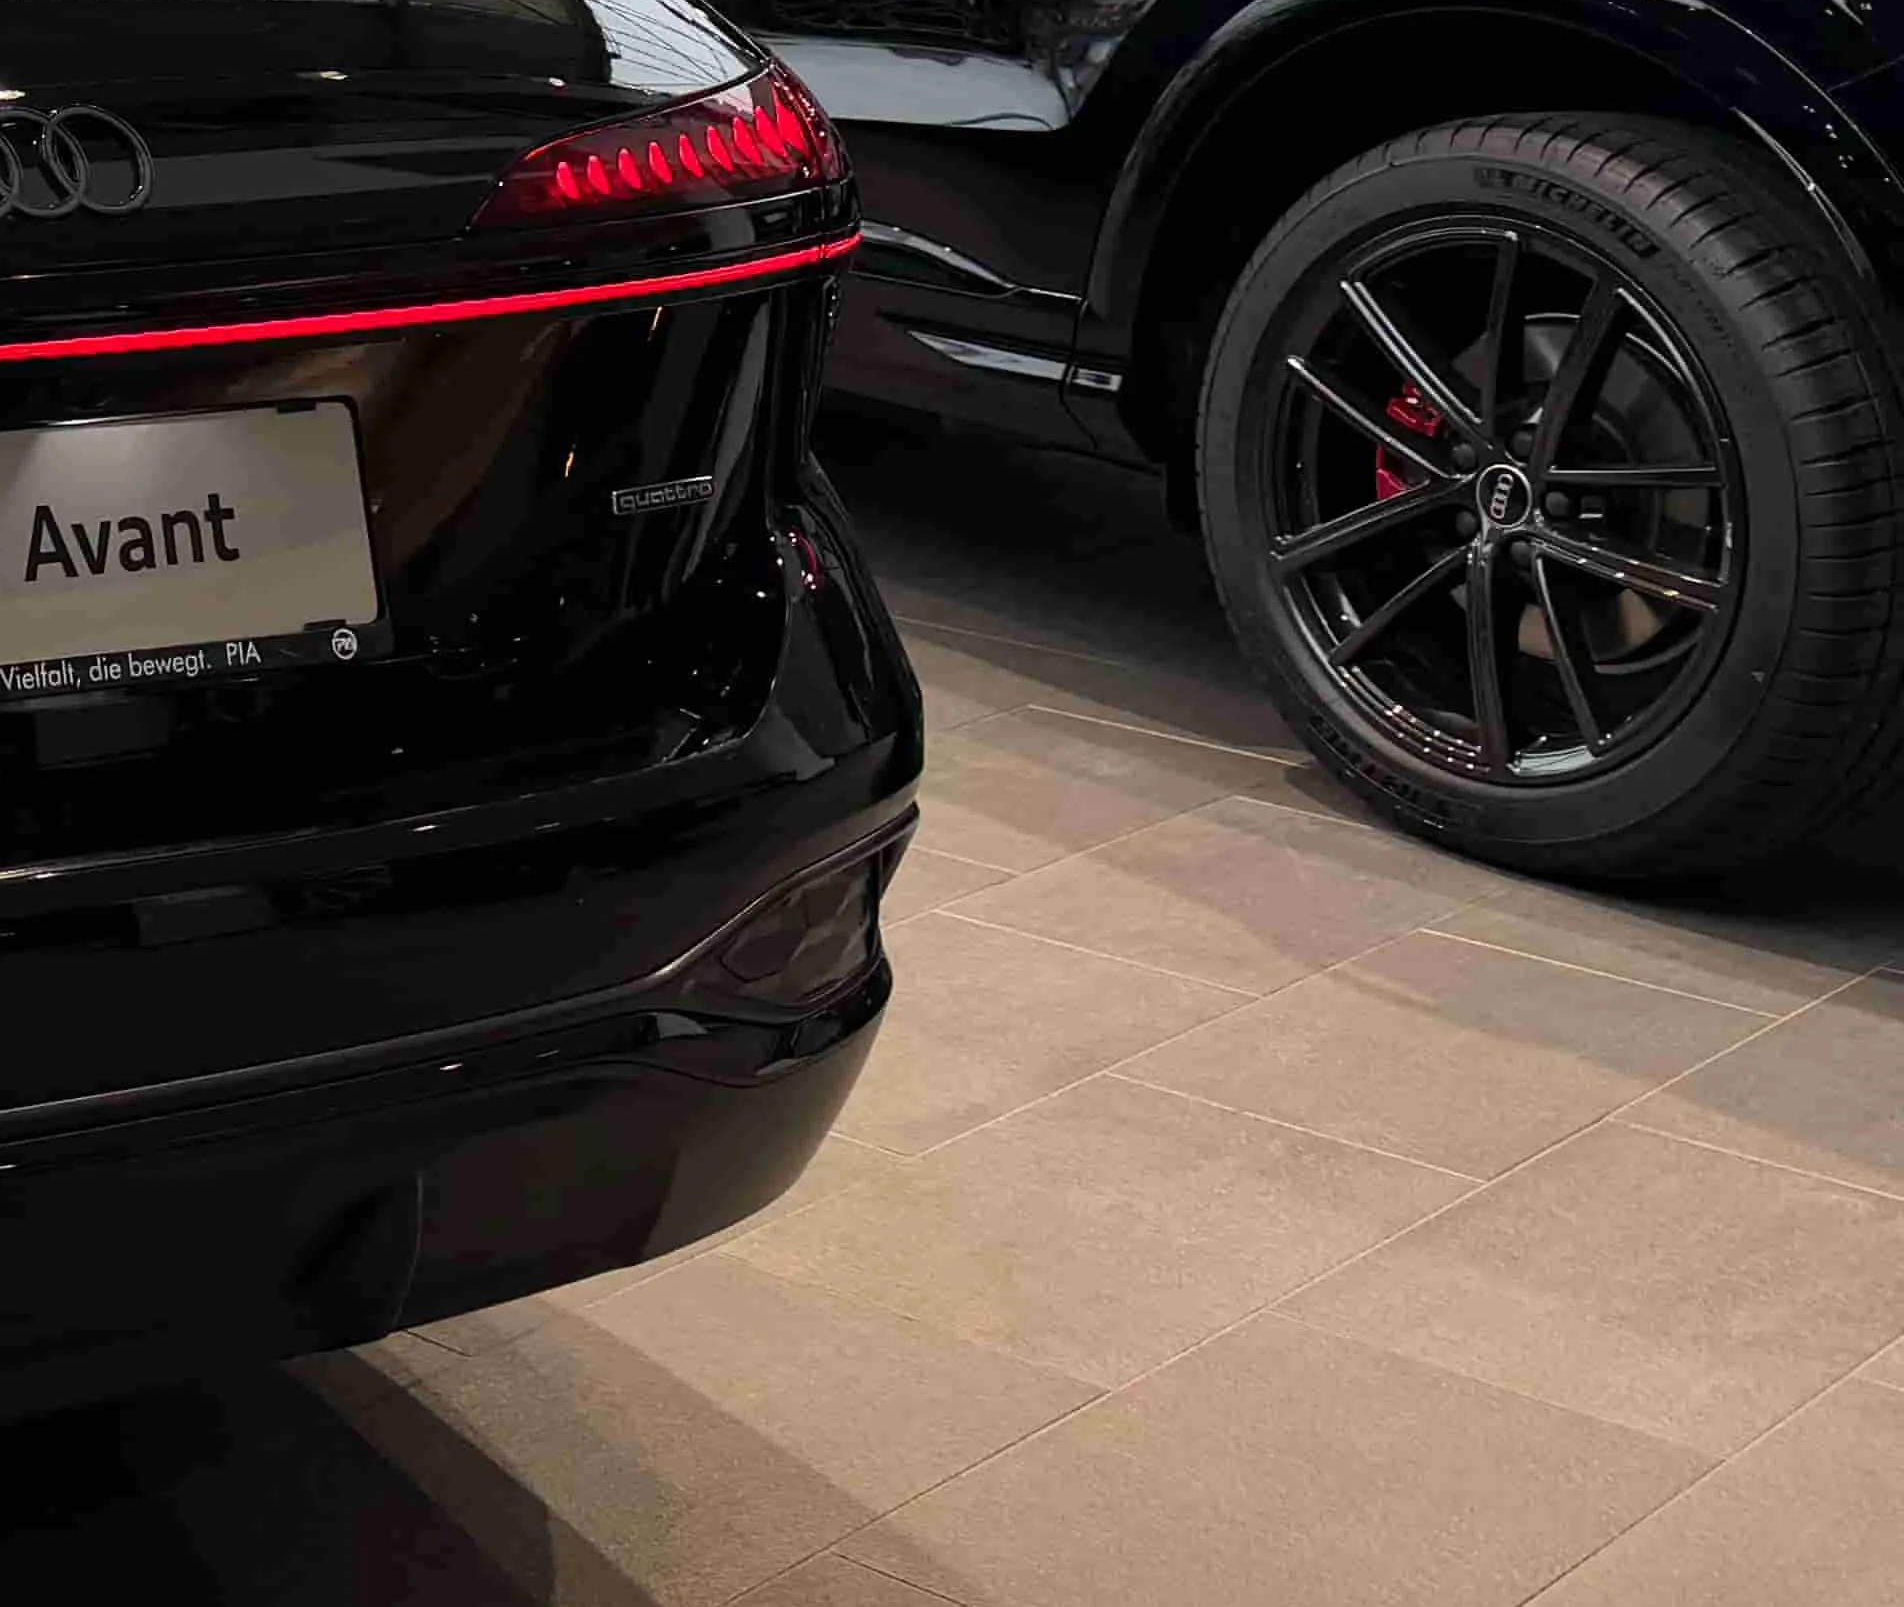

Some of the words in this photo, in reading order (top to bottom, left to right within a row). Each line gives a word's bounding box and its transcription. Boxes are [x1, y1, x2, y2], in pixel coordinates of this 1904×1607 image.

[619, 483, 713, 512] quattro
[25, 493, 240, 582] Avant
[0, 662, 81, 691] Vielfalt,
[89, 656, 121, 682] die
[128, 649, 212, 679] bewegt.
[225, 640, 262, 667] PIA
